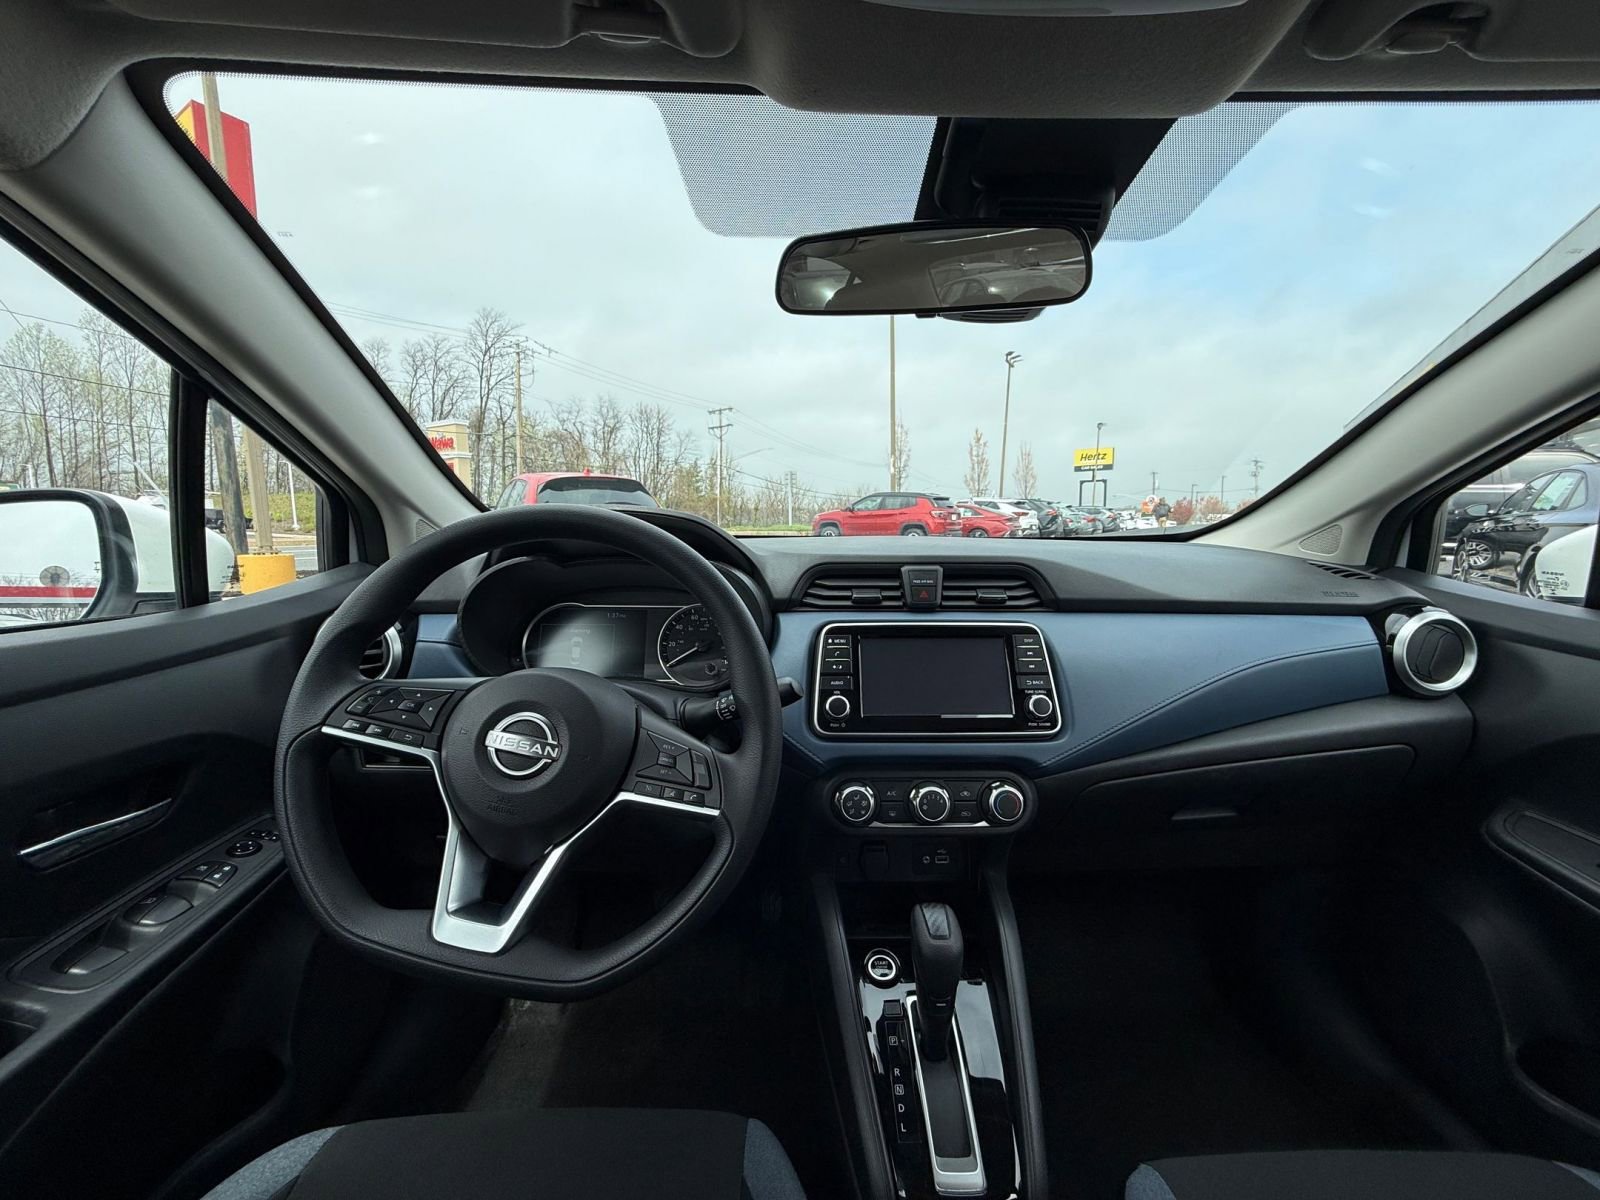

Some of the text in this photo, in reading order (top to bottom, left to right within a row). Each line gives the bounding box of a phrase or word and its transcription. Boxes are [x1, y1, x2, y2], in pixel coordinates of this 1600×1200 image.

[1080, 452, 1107, 461] Hertz
[487, 733, 558, 758] NISSAN
[894, 1068, 900, 1077] R
[898, 1104, 905, 1113] D
[901, 1123, 907, 1133] L
